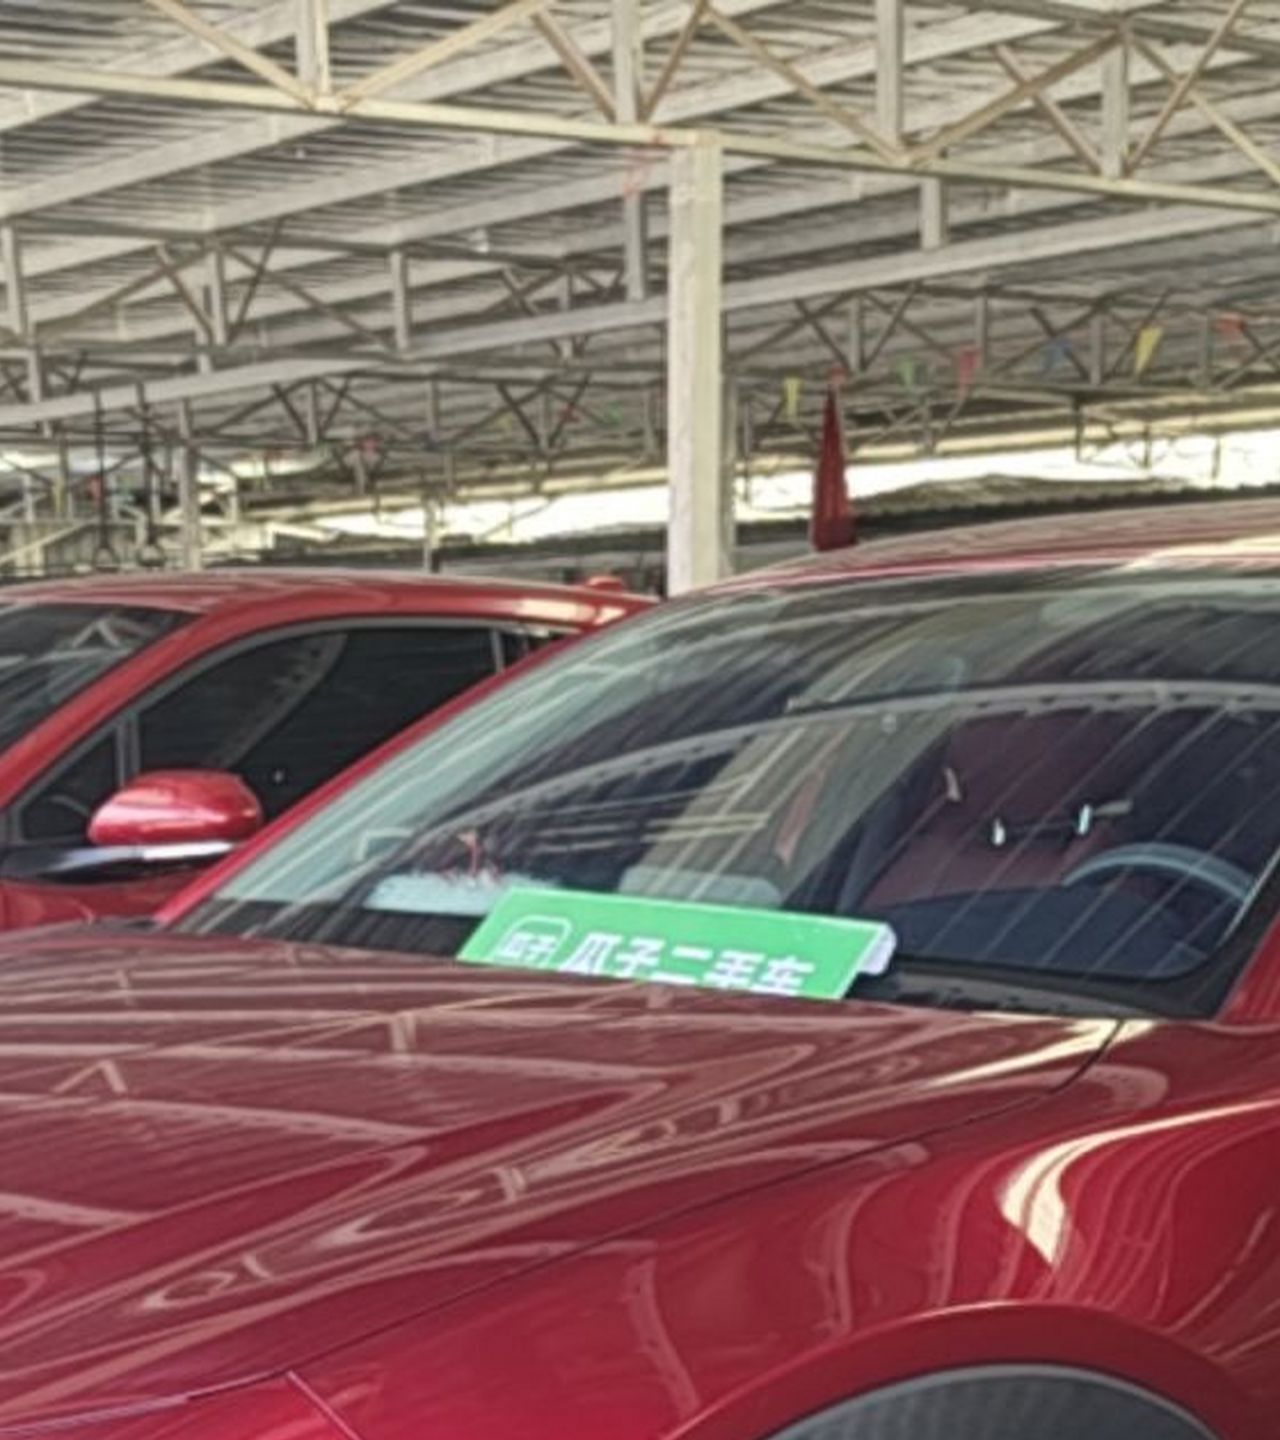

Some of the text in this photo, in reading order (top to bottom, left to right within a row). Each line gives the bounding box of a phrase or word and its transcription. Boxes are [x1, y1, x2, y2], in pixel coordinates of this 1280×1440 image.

[558, 932, 815, 995] 瓜子二手车
